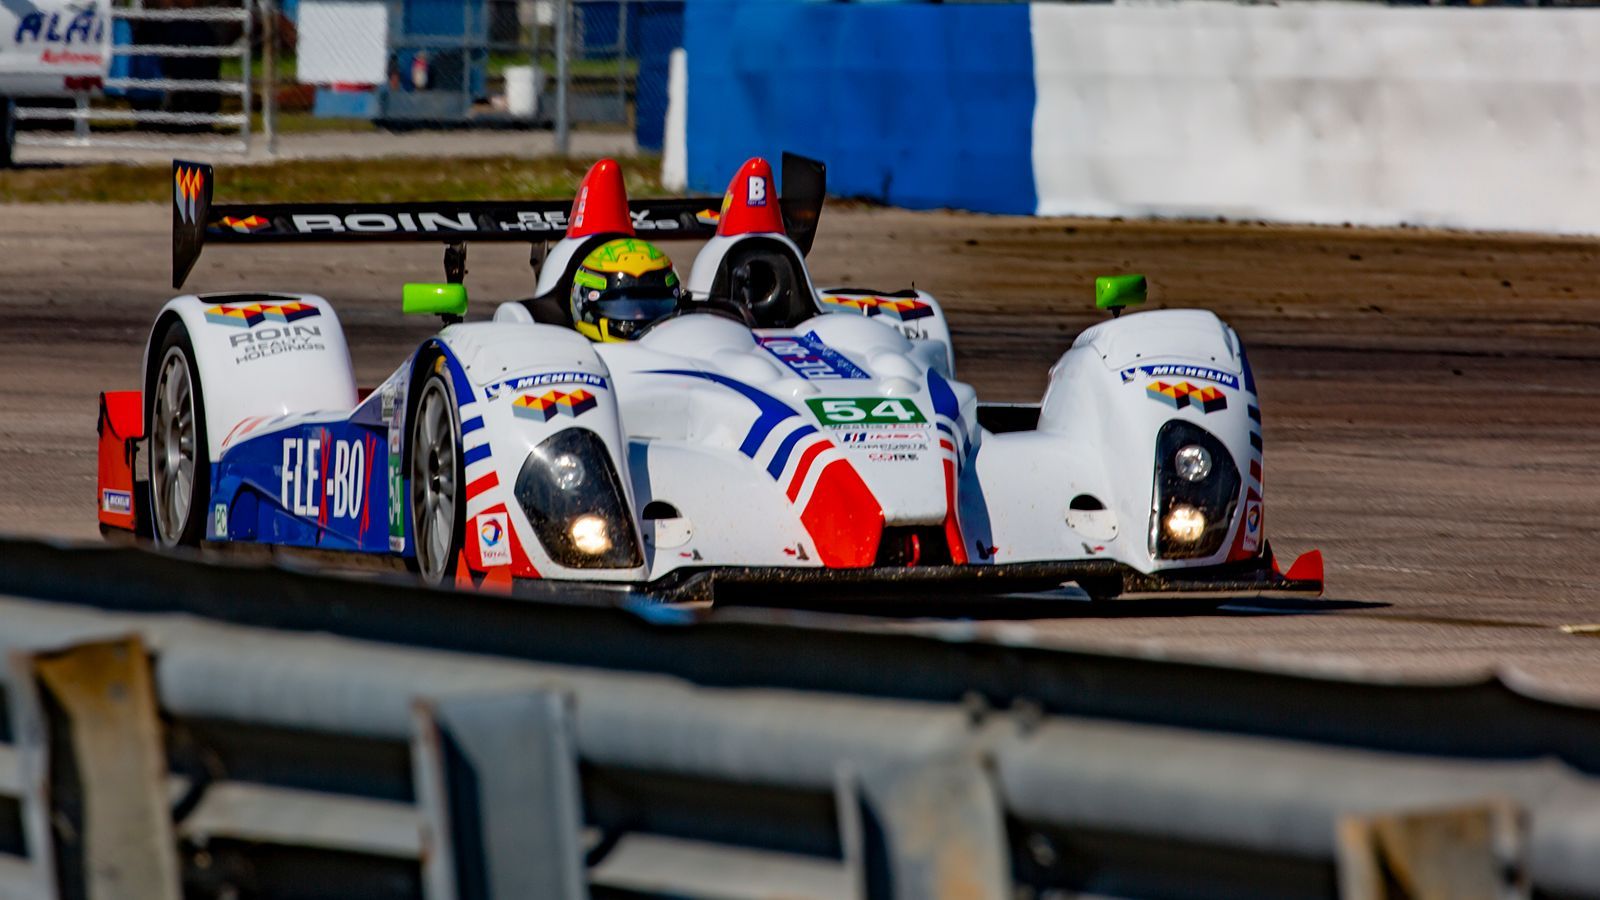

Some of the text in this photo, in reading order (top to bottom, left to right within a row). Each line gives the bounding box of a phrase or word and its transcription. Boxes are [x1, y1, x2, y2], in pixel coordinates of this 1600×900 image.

[749, 176, 765, 200] B
[291, 212, 478, 233] ROIN
[517, 210, 650, 223] REY
[229, 325, 322, 348] ROIN
[244, 334, 313, 353] REALTY
[236, 343, 326, 365] HOLDINGS
[516, 372, 602, 389] MICHELIN
[1151, 366, 1234, 384] MICHELIN
[822, 400, 916, 421] 54
[389, 464, 401, 525] 54
[216, 507, 227, 532] PC
